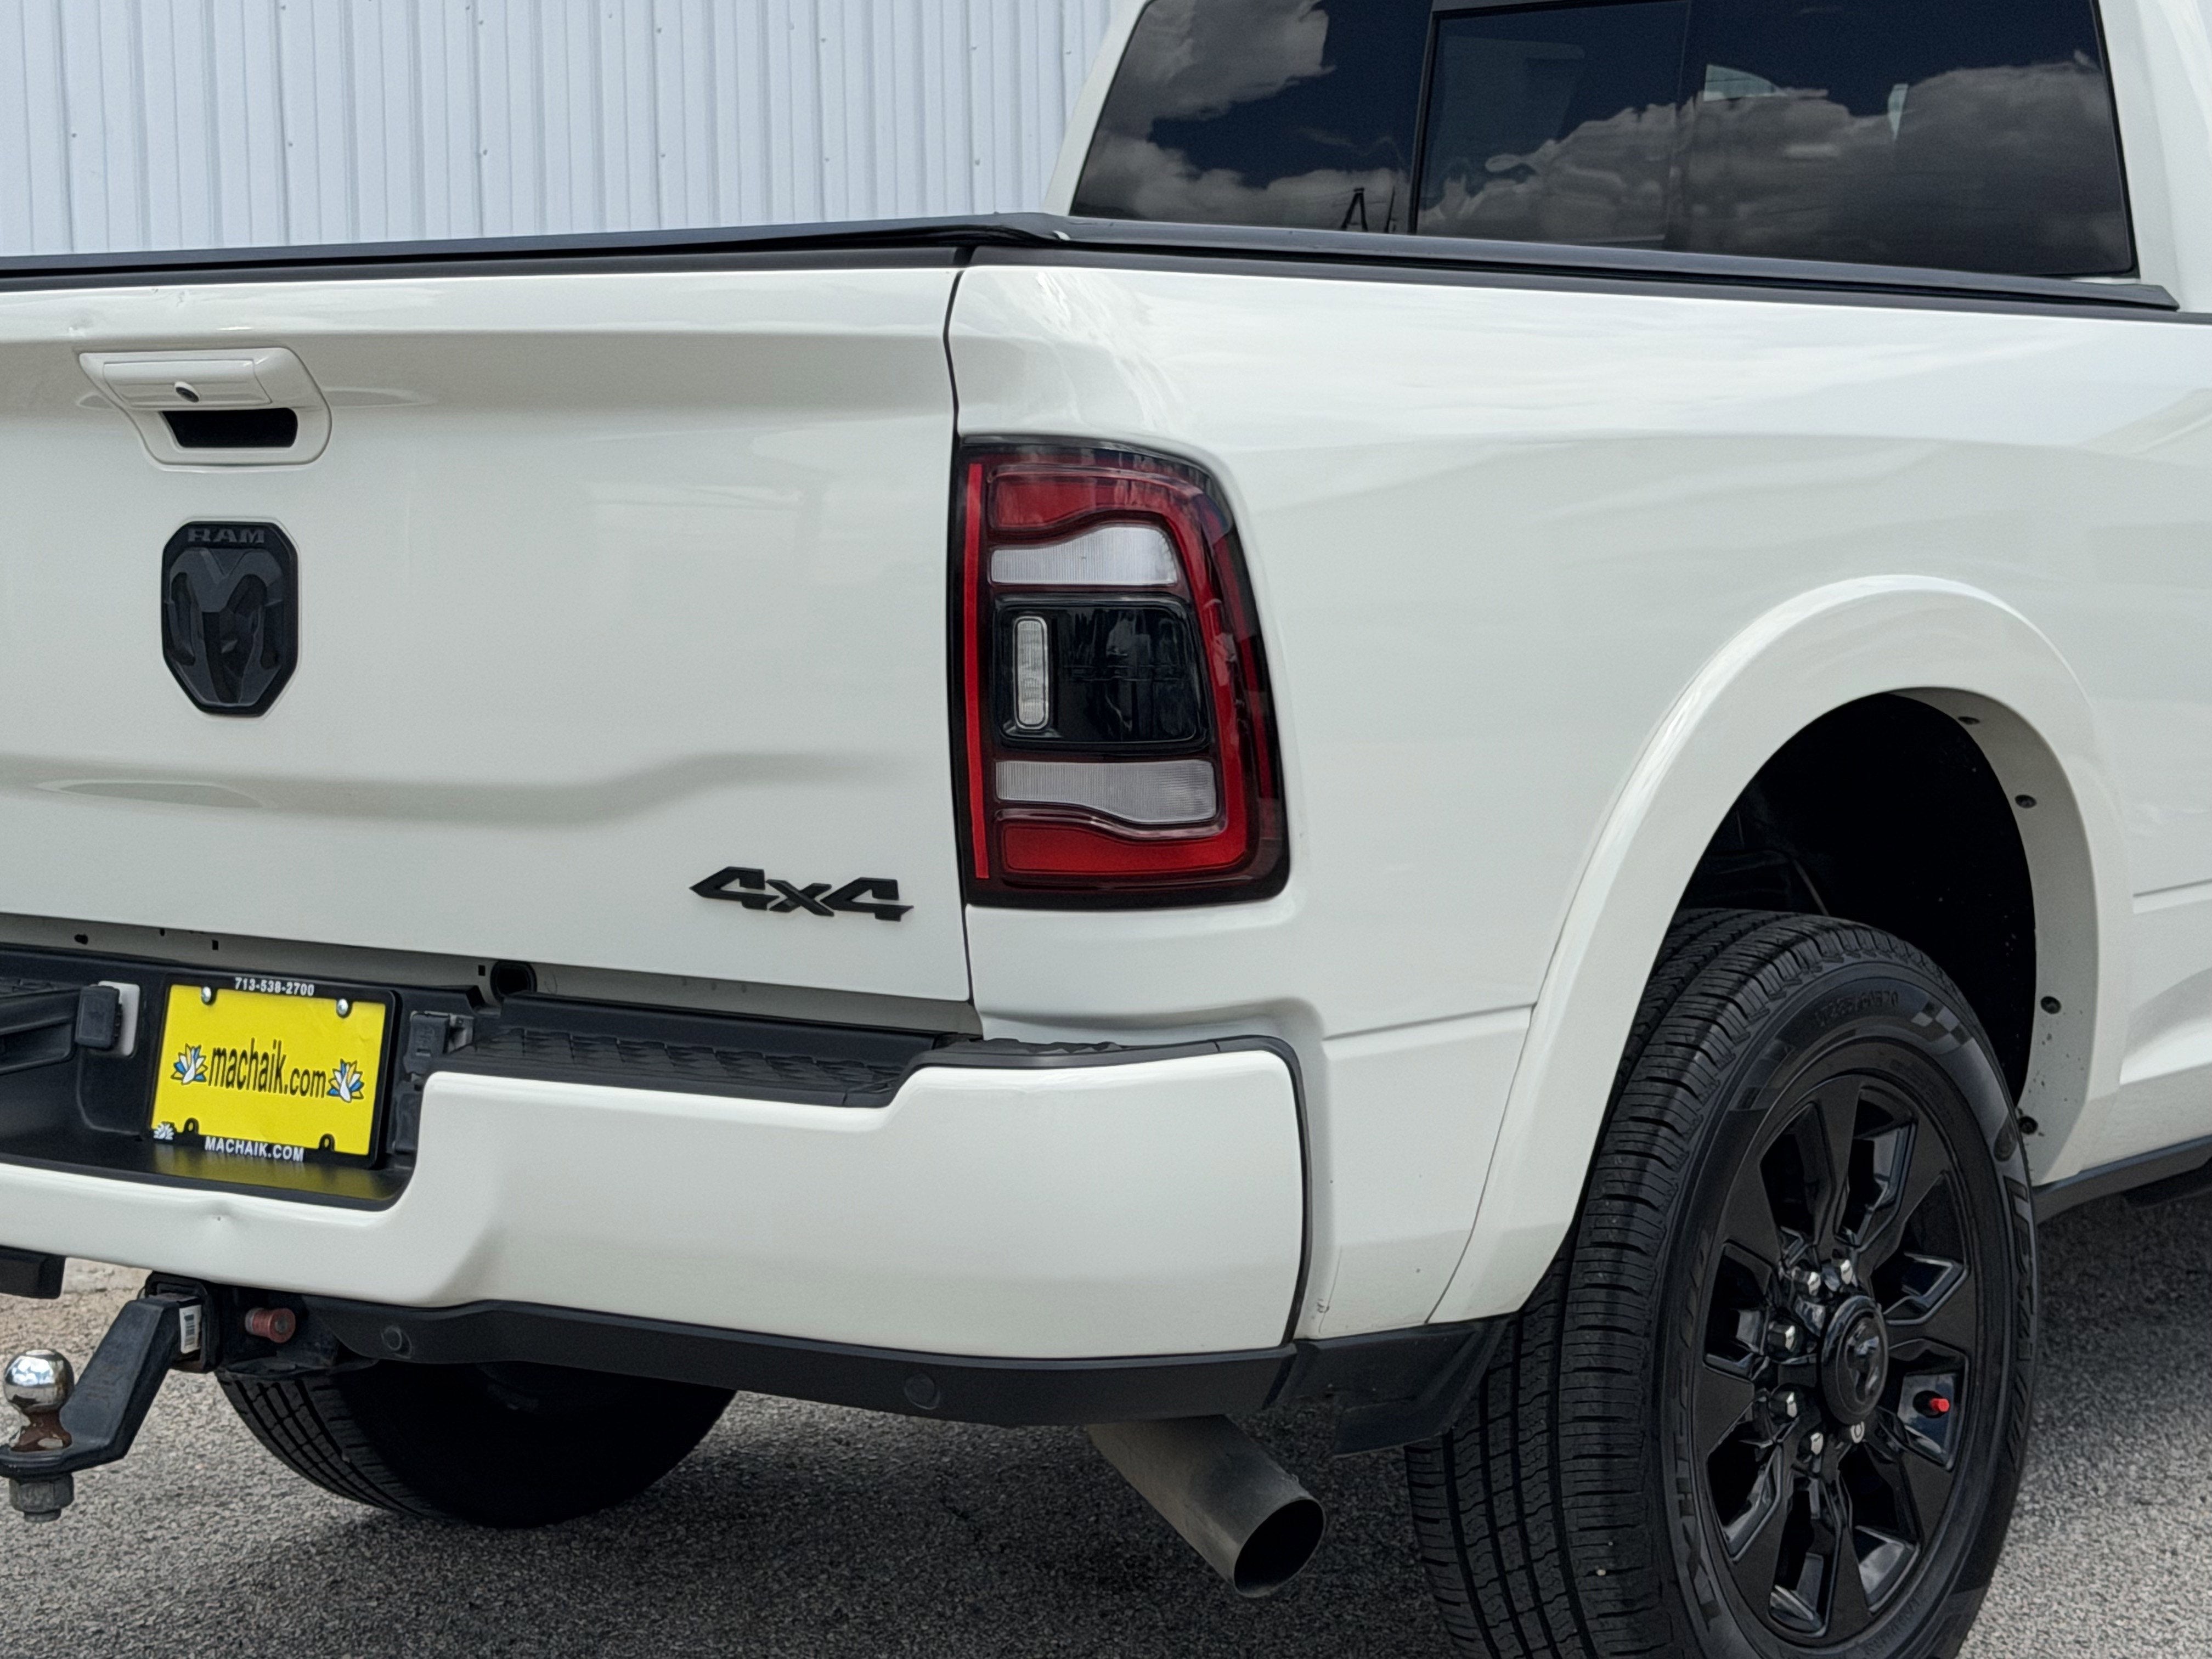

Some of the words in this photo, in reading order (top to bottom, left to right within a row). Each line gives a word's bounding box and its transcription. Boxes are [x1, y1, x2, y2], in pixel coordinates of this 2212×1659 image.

[188, 528, 265, 544] RAM
[689, 866, 914, 922] 4x4
[235, 977, 315, 996] 713-538-2700
[208, 1037, 326, 1098] machaik.com
[204, 1136, 304, 1162] MACHAIK.COM
